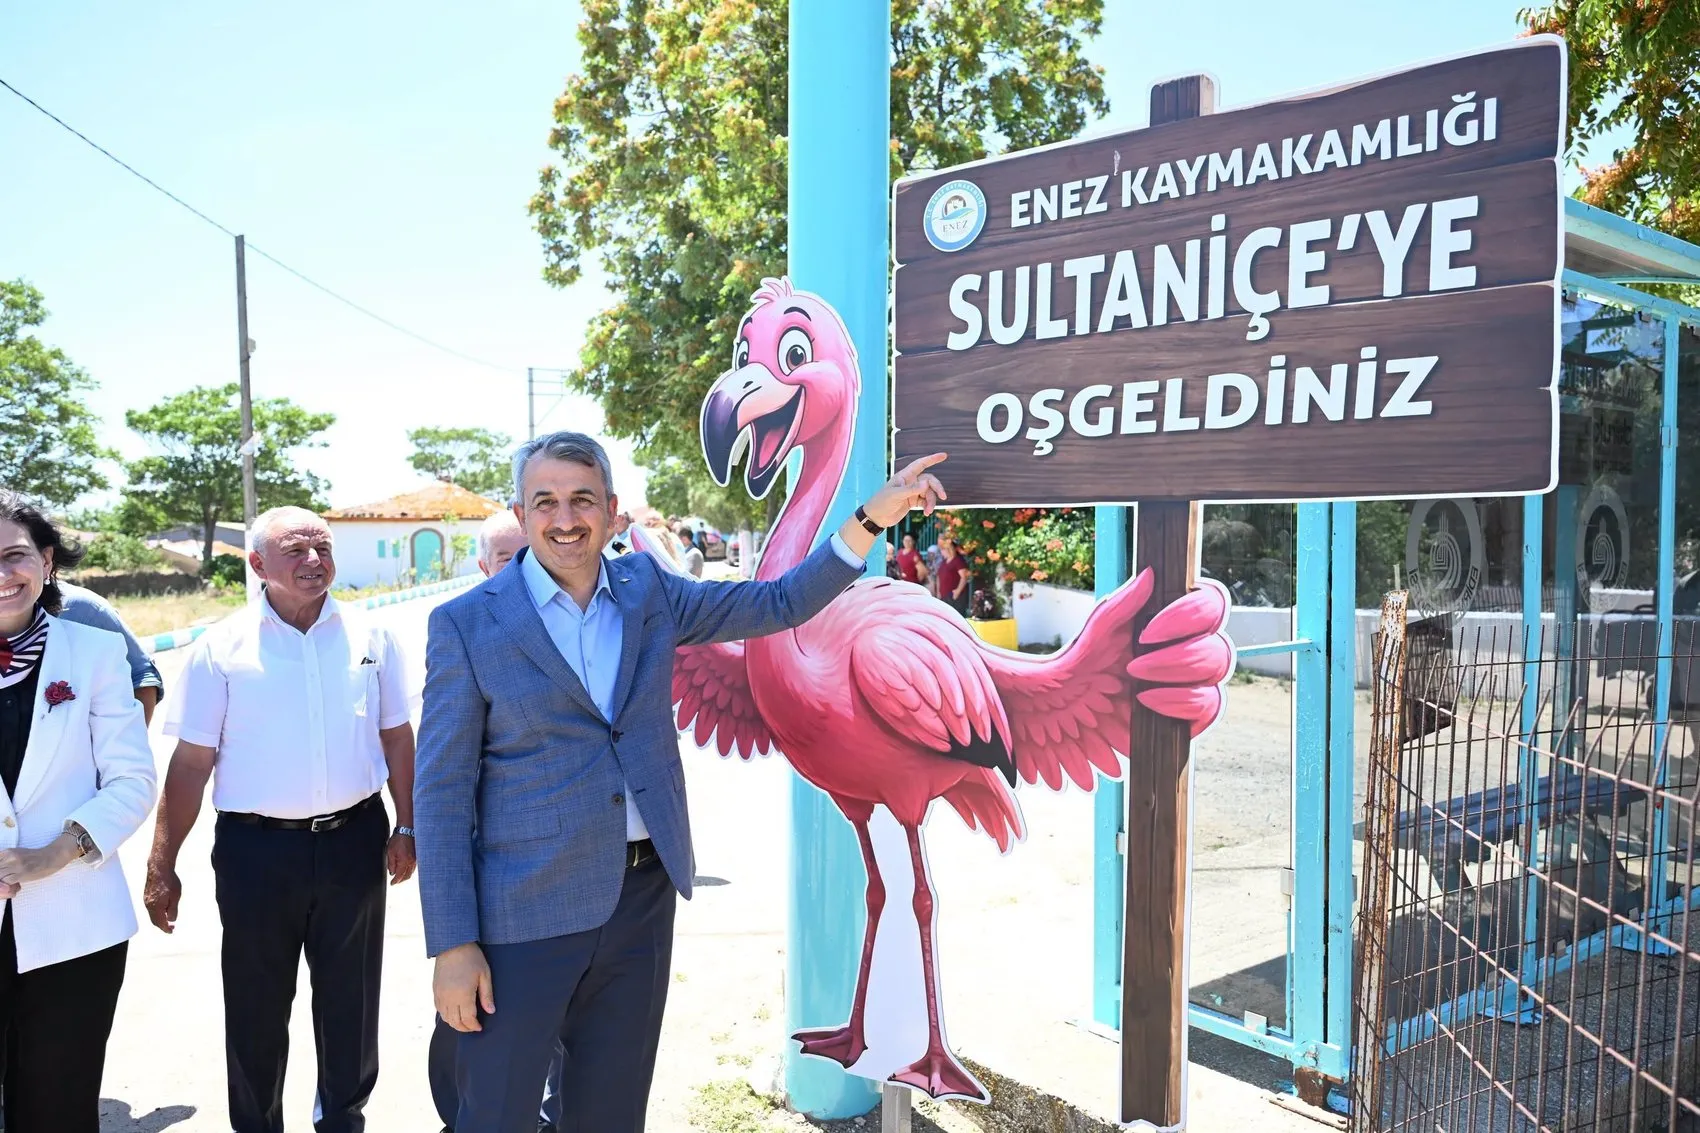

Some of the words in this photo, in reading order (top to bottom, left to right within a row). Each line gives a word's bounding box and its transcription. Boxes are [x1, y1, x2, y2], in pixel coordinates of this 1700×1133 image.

[1010, 174, 1110, 228] ENEZ
[1121, 90, 1498, 208] KAYMAKAMLIĞI
[942, 219, 968, 233] ENEZ
[946, 195, 1479, 351] SULTANİÇE'YE
[976, 346, 1440, 456] OŞGELDİNİZ
